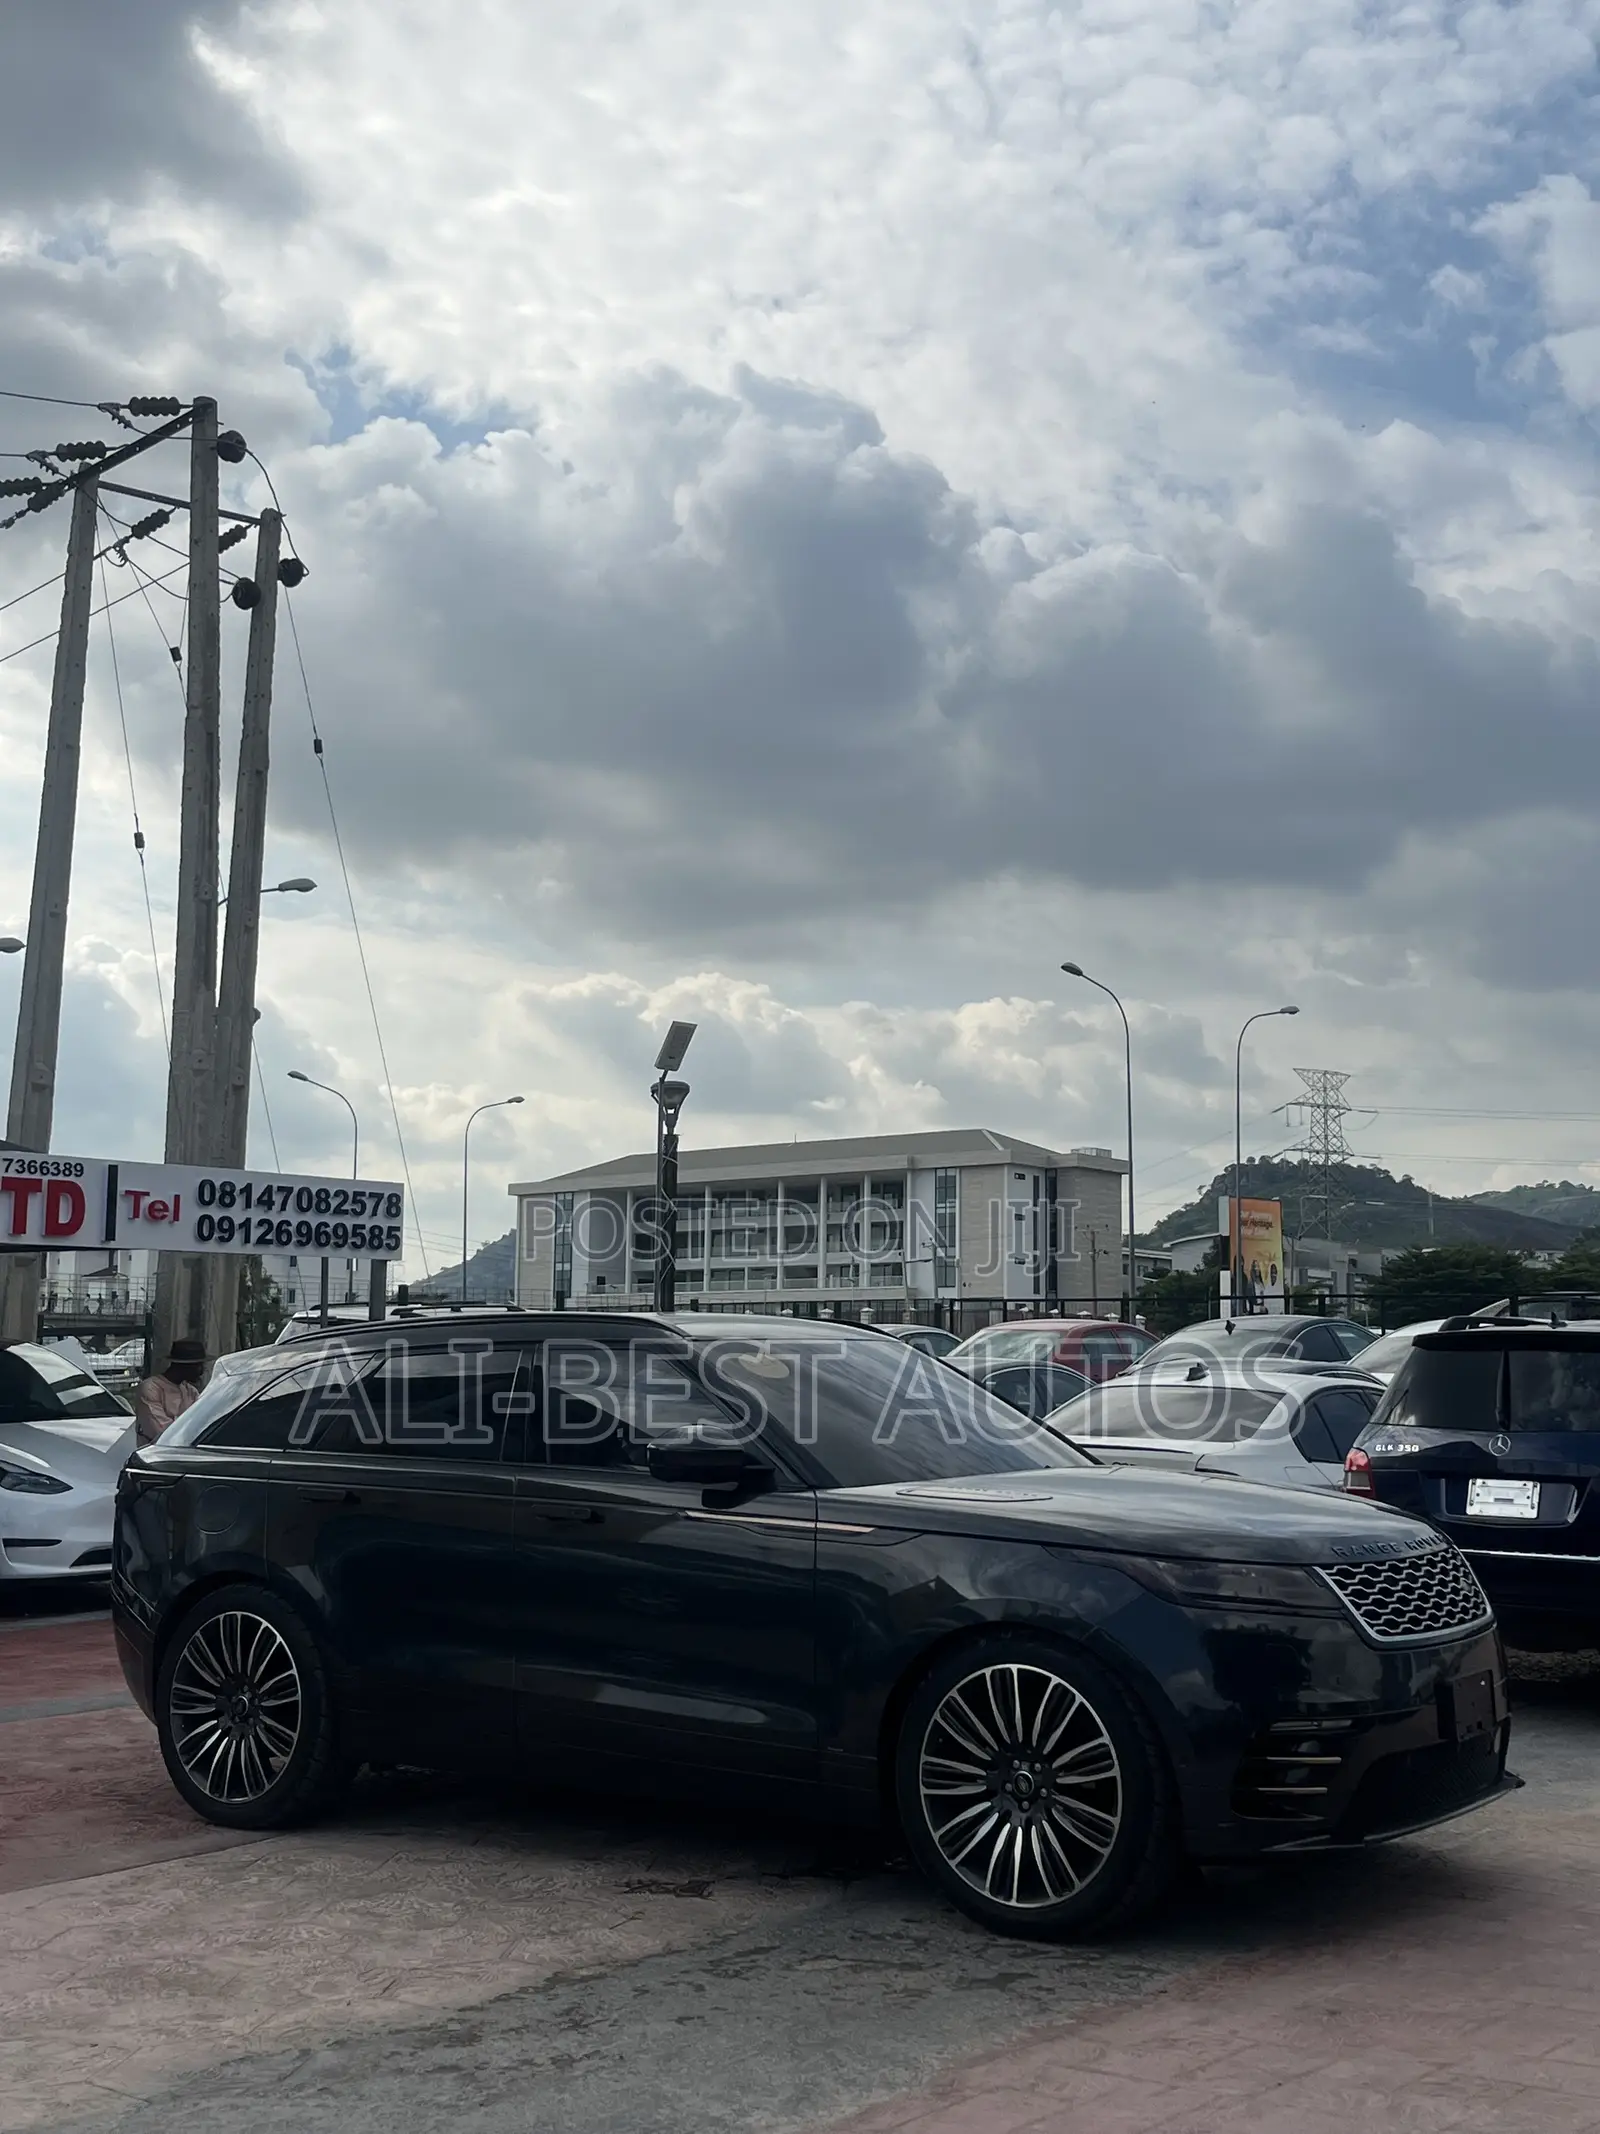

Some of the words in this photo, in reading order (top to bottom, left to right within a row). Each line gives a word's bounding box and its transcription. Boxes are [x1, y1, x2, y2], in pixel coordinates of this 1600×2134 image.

[2, 1158, 85, 1178] 7366389
[124, 1189, 181, 1222] Tel
[197, 1178, 402, 1219] 08147082578
[196, 1213, 401, 1251] 09126969585
[1375, 1444, 1394, 1452] GLK
[1397, 1444, 1419, 1453] 350
[1331, 1541, 1402, 1558] RANGE
